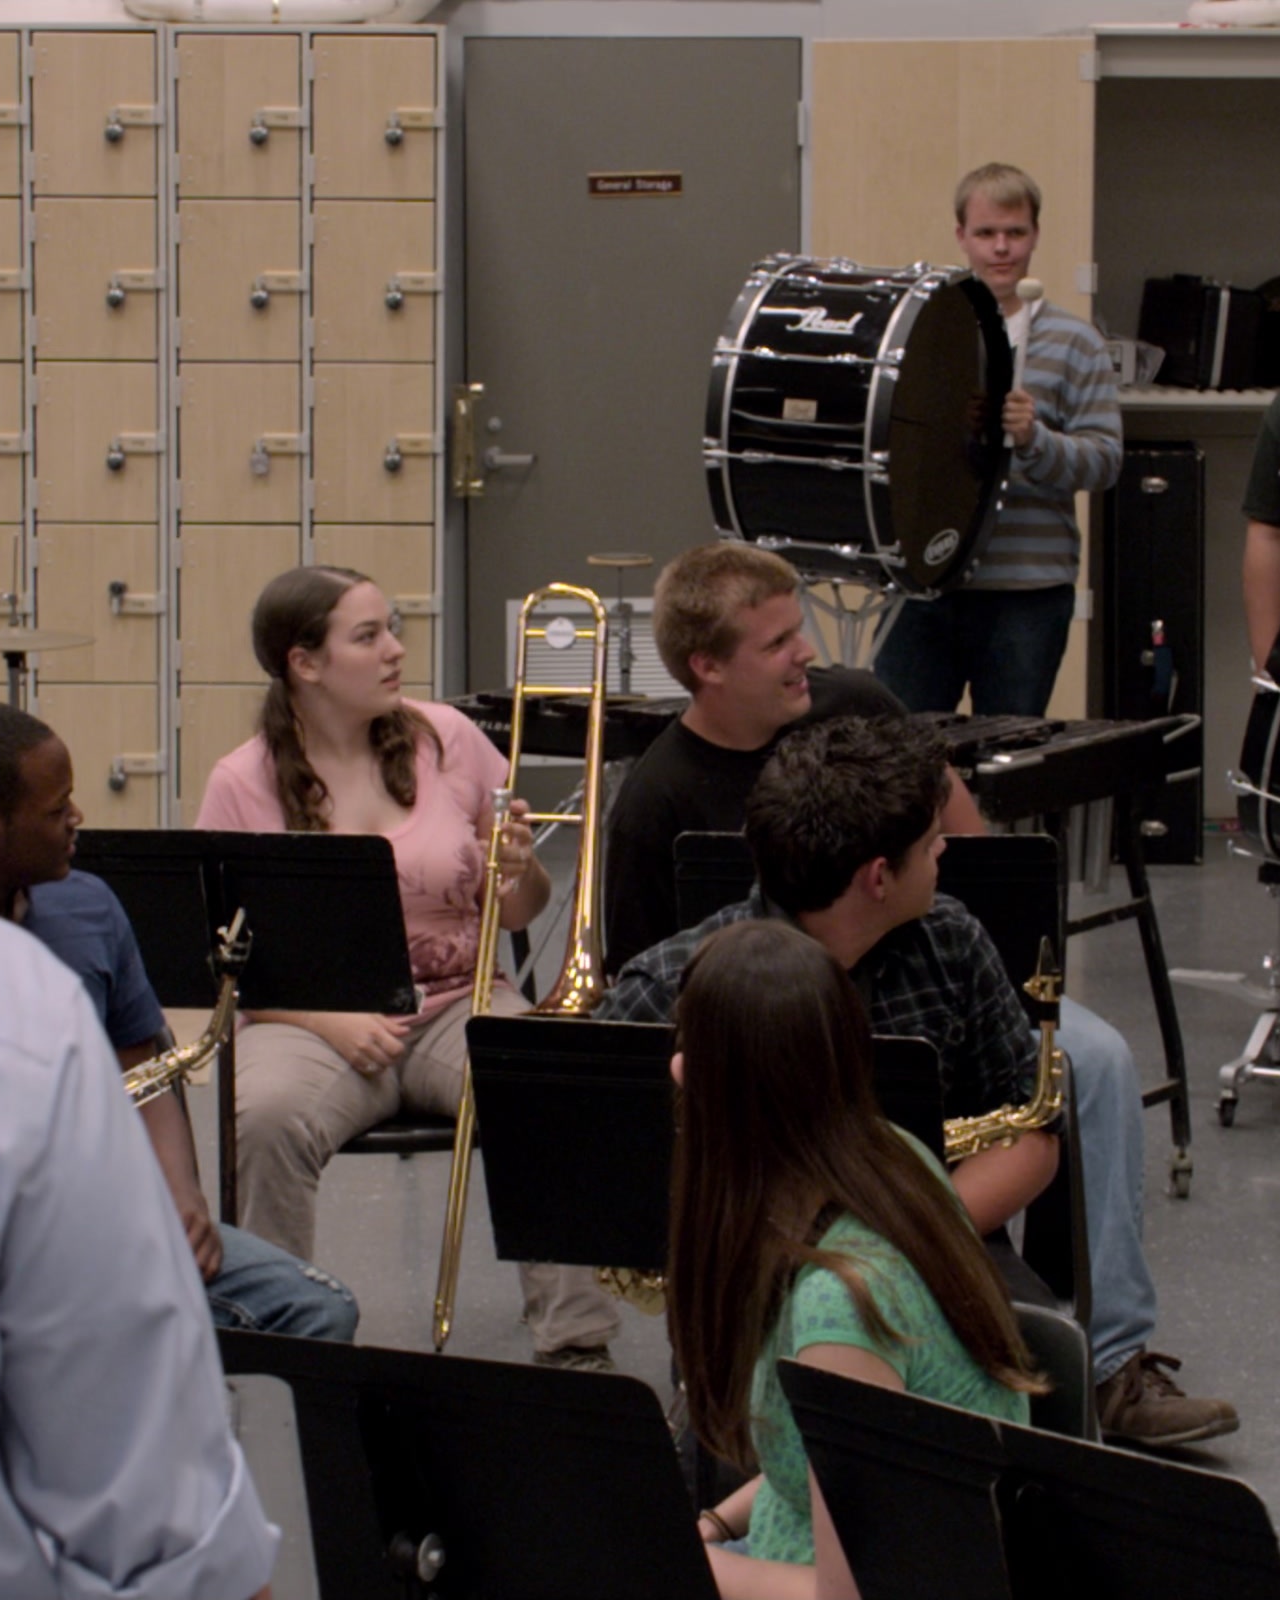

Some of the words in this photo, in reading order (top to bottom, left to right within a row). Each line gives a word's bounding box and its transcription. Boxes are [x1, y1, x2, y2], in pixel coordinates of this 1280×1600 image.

[597, 179, 632, 191] General
[636, 179, 672, 191] Storage
[784, 305, 863, 335] Pearl
